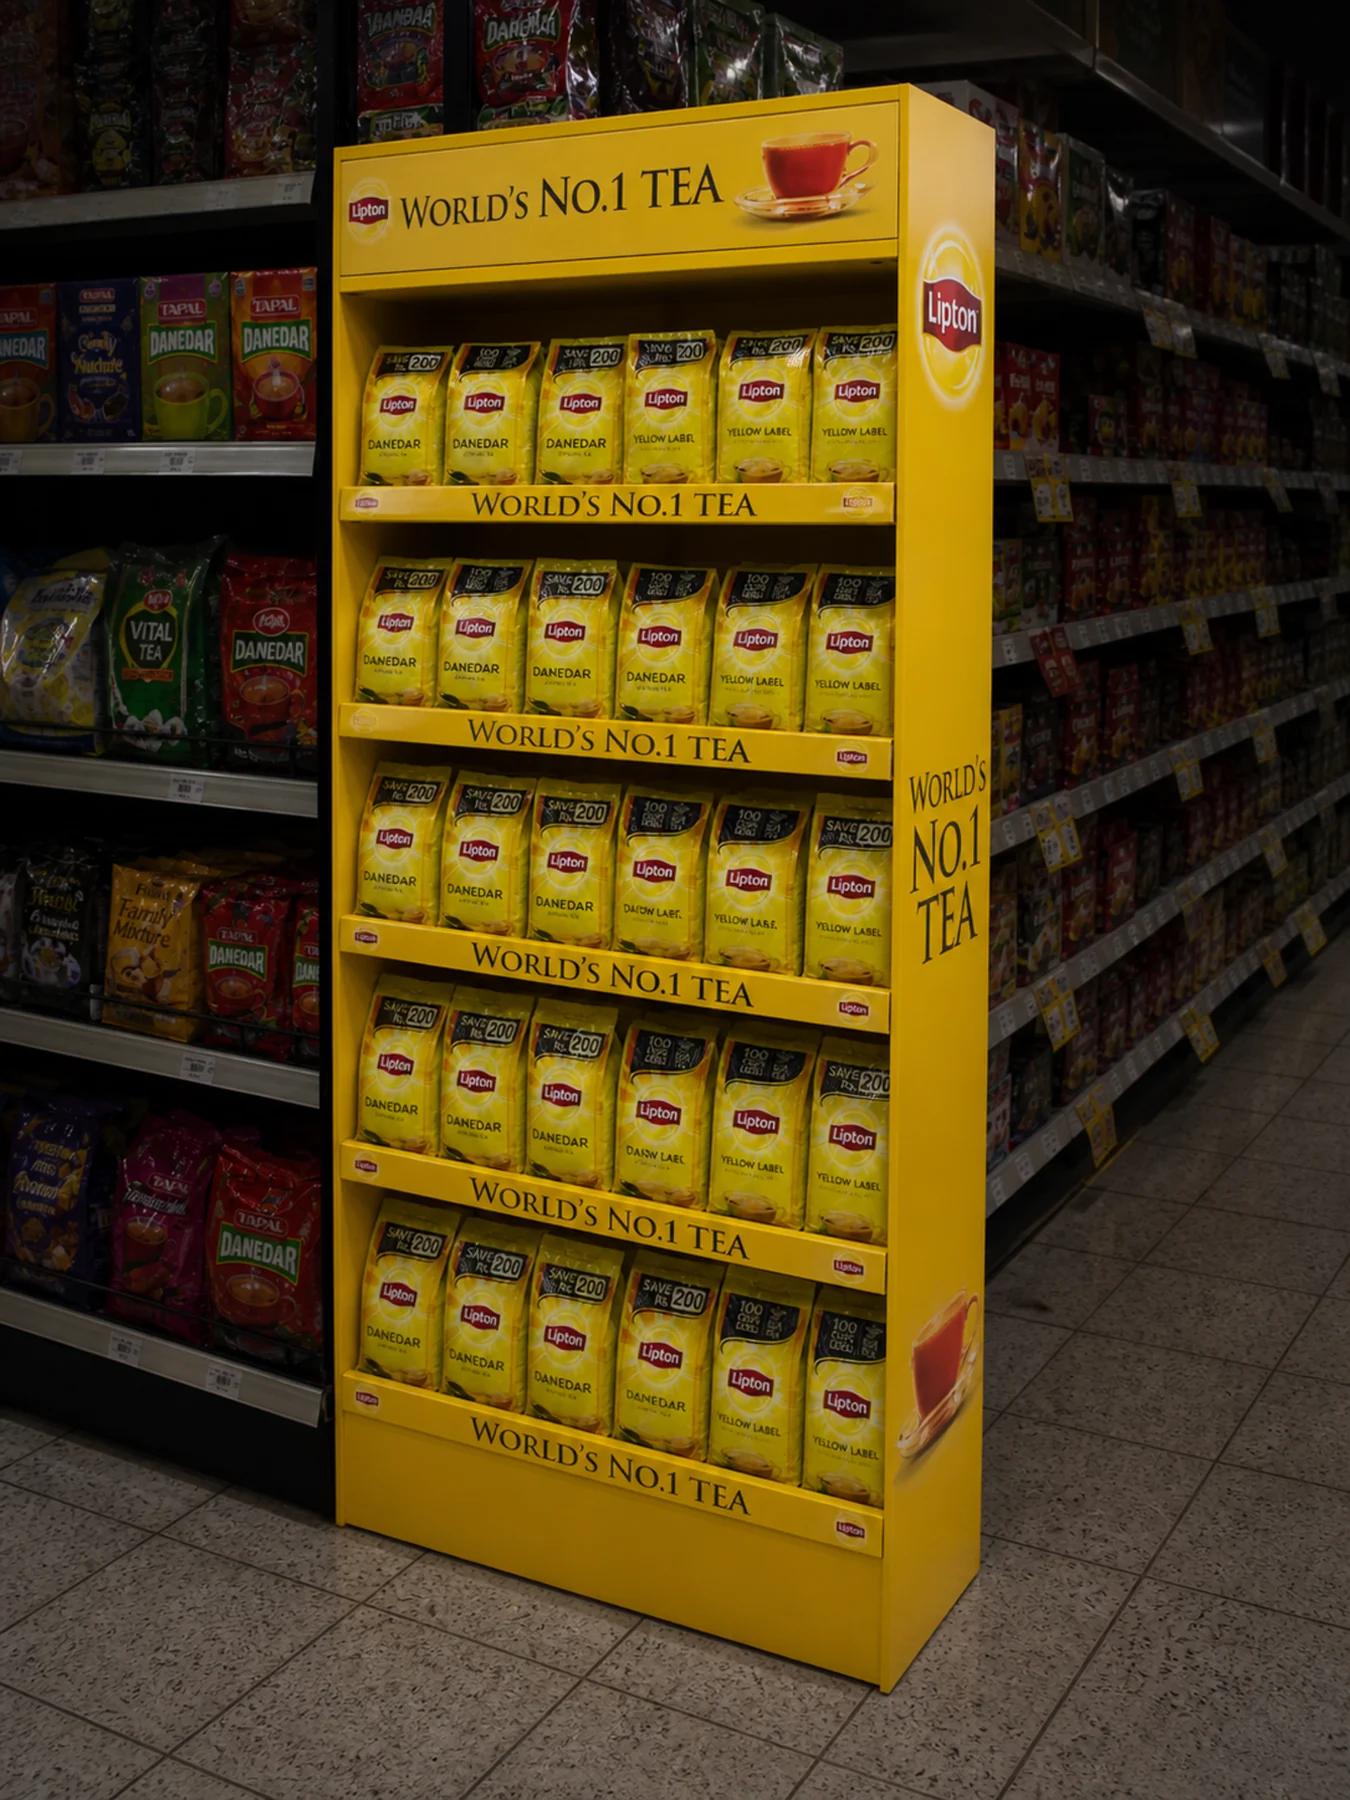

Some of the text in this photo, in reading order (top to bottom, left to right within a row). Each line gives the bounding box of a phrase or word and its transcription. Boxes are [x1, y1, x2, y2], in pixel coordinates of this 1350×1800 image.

[640, 164, 724, 209] TEA
[352, 203, 385, 220] Lipton
[159, 302, 203, 316] TAPAL
[252, 298, 297, 313] TAPAL
[929, 291, 977, 334] Lipton
[150, 329, 214, 355] DANEDAR
[243, 324, 309, 351] DANEDAR
[861, 334, 894, 347] 200
[591, 349, 619, 364] 200
[742, 385, 780, 397] Lipton
[838, 384, 877, 397] Lipton
[383, 398, 414, 412] Lipton
[467, 397, 501, 409] Lipton
[563, 397, 599, 409] Lipton
[649, 393, 685, 406] Lipton
[822, 427, 887, 436] YELLOW LABEL
[368, 439, 421, 450] DANEDAR
[453, 439, 509, 449] DANEDAR
[546, 438, 606, 449] DANEDAR
[694, 493, 757, 516] TEA
[411, 574, 437, 586] 200
[574, 577, 601, 592] 200
[650, 572, 672, 582] 100
[747, 574, 769, 584] 100
[839, 577, 862, 587] 100
[129, 620, 173, 642] VITAL
[458, 621, 493, 634] Lipton
[547, 624, 583, 637] Lipton
[641, 629, 678, 643] Lipton
[737, 632, 775, 645] Lipton
[830, 634, 869, 649] Lipton
[139, 644, 162, 661] TEA
[235, 640, 304, 665] DANEDAR
[364, 654, 416, 667] DANEDAR
[444, 661, 499, 674] DANEDAR
[533, 666, 591, 679] DANEDAR
[627, 671, 685, 684] DANEDAR
[815, 680, 850, 689] YELLOW
[688, 736, 752, 763] TEA
[409, 785, 436, 799] 200
[494, 793, 520, 809] 200
[644, 802, 667, 813] 100
[577, 804, 606, 821] 200
[739, 810, 761, 821] 100
[379, 831, 411, 846] Lipton
[826, 820, 892, 842] SAVE 200
[462, 843, 496, 858] Lipton
[910, 804, 980, 893] NO.1
[551, 855, 585, 868] Lipton
[364, 871, 416, 886] DANEDAR
[637, 863, 673, 879] Lipton
[730, 872, 767, 886] Lipton
[831, 879, 872, 894] Lipton
[447, 884, 503, 900] DANEDAR
[536, 896, 593, 911] DANEDAR
[816, 921, 882, 936] YELLOW LABEL
[916, 880, 978, 965] TEA
[113, 920, 171, 948] Mixture
[210, 943, 264, 974] DANEDAR
[691, 976, 754, 1007] TEA
[409, 1008, 435, 1024] 200
[488, 1022, 514, 1039] 200
[572, 1036, 599, 1053] 200
[650, 1036, 672, 1048] 100
[745, 1047, 767, 1060] 100
[380, 1056, 411, 1071] Lipton
[829, 1066, 860, 1080] SAVE
[460, 1075, 493, 1088] Lipton
[545, 1088, 579, 1103] Lipton
[365, 1097, 418, 1115] DANEDAR
[639, 1104, 678, 1121] Lipton
[446, 1115, 502, 1132] DANEDAR
[737, 1114, 776, 1130] Lipton
[532, 1129, 588, 1148] DANEDAR
[833, 1129, 873, 1146] Lipton
[721, 1155, 784, 1174] YELLOW LABEL
[817, 1171, 851, 1186] YELLOW
[414, 1236, 441, 1254] 200
[687, 1224, 749, 1260] TEA
[220, 1230, 297, 1276] DANEDAR
[465, 1247, 522, 1275] SAVE 200
[548, 1268, 605, 1296] SAVE 200
[383, 1285, 414, 1301] Lipton
[643, 1280, 703, 1309] SAVE 200
[740, 1301, 763, 1315] 100
[464, 1309, 497, 1326] Lipton
[833, 1318, 858, 1332] 100
[367, 1326, 420, 1348] DANEDAR
[548, 1329, 582, 1346] Lipton
[449, 1348, 504, 1371] DANEDAR
[642, 1345, 679, 1364] Lipton
[534, 1371, 591, 1394] DANEDAR
[732, 1372, 770, 1392] Lipton
[626, 1390, 686, 1412] DANEDAR
[827, 1394, 867, 1414] Lipton
[717, 1412, 780, 1436] YELLOW LABEL
[690, 1477, 750, 1516] TEA
